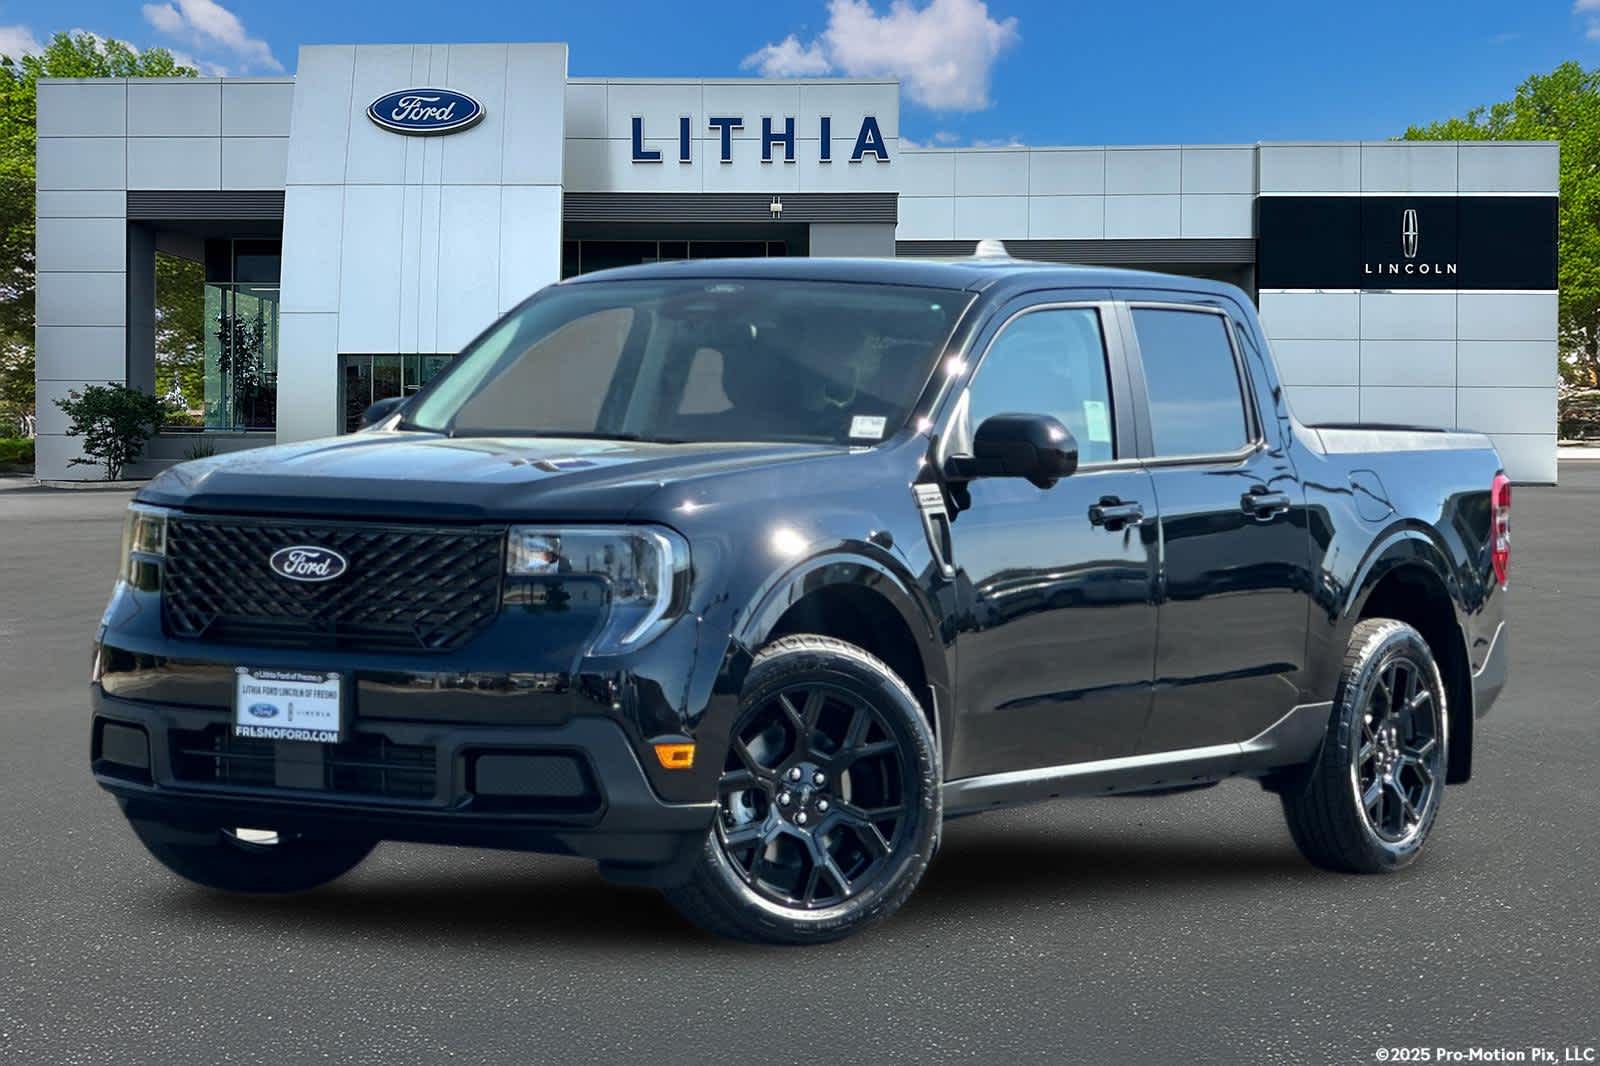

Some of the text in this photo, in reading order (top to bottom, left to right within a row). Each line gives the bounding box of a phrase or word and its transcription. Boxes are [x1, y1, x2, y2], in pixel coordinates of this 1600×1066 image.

[391, 95, 456, 121] Ford
[630, 115, 890, 164] LITHIA
[1364, 263, 1457, 274] LINCOLN
[283, 550, 331, 576] Ford
[242, 685, 337, 700] LITHIA FORD LINCOLN OF FRESNO
